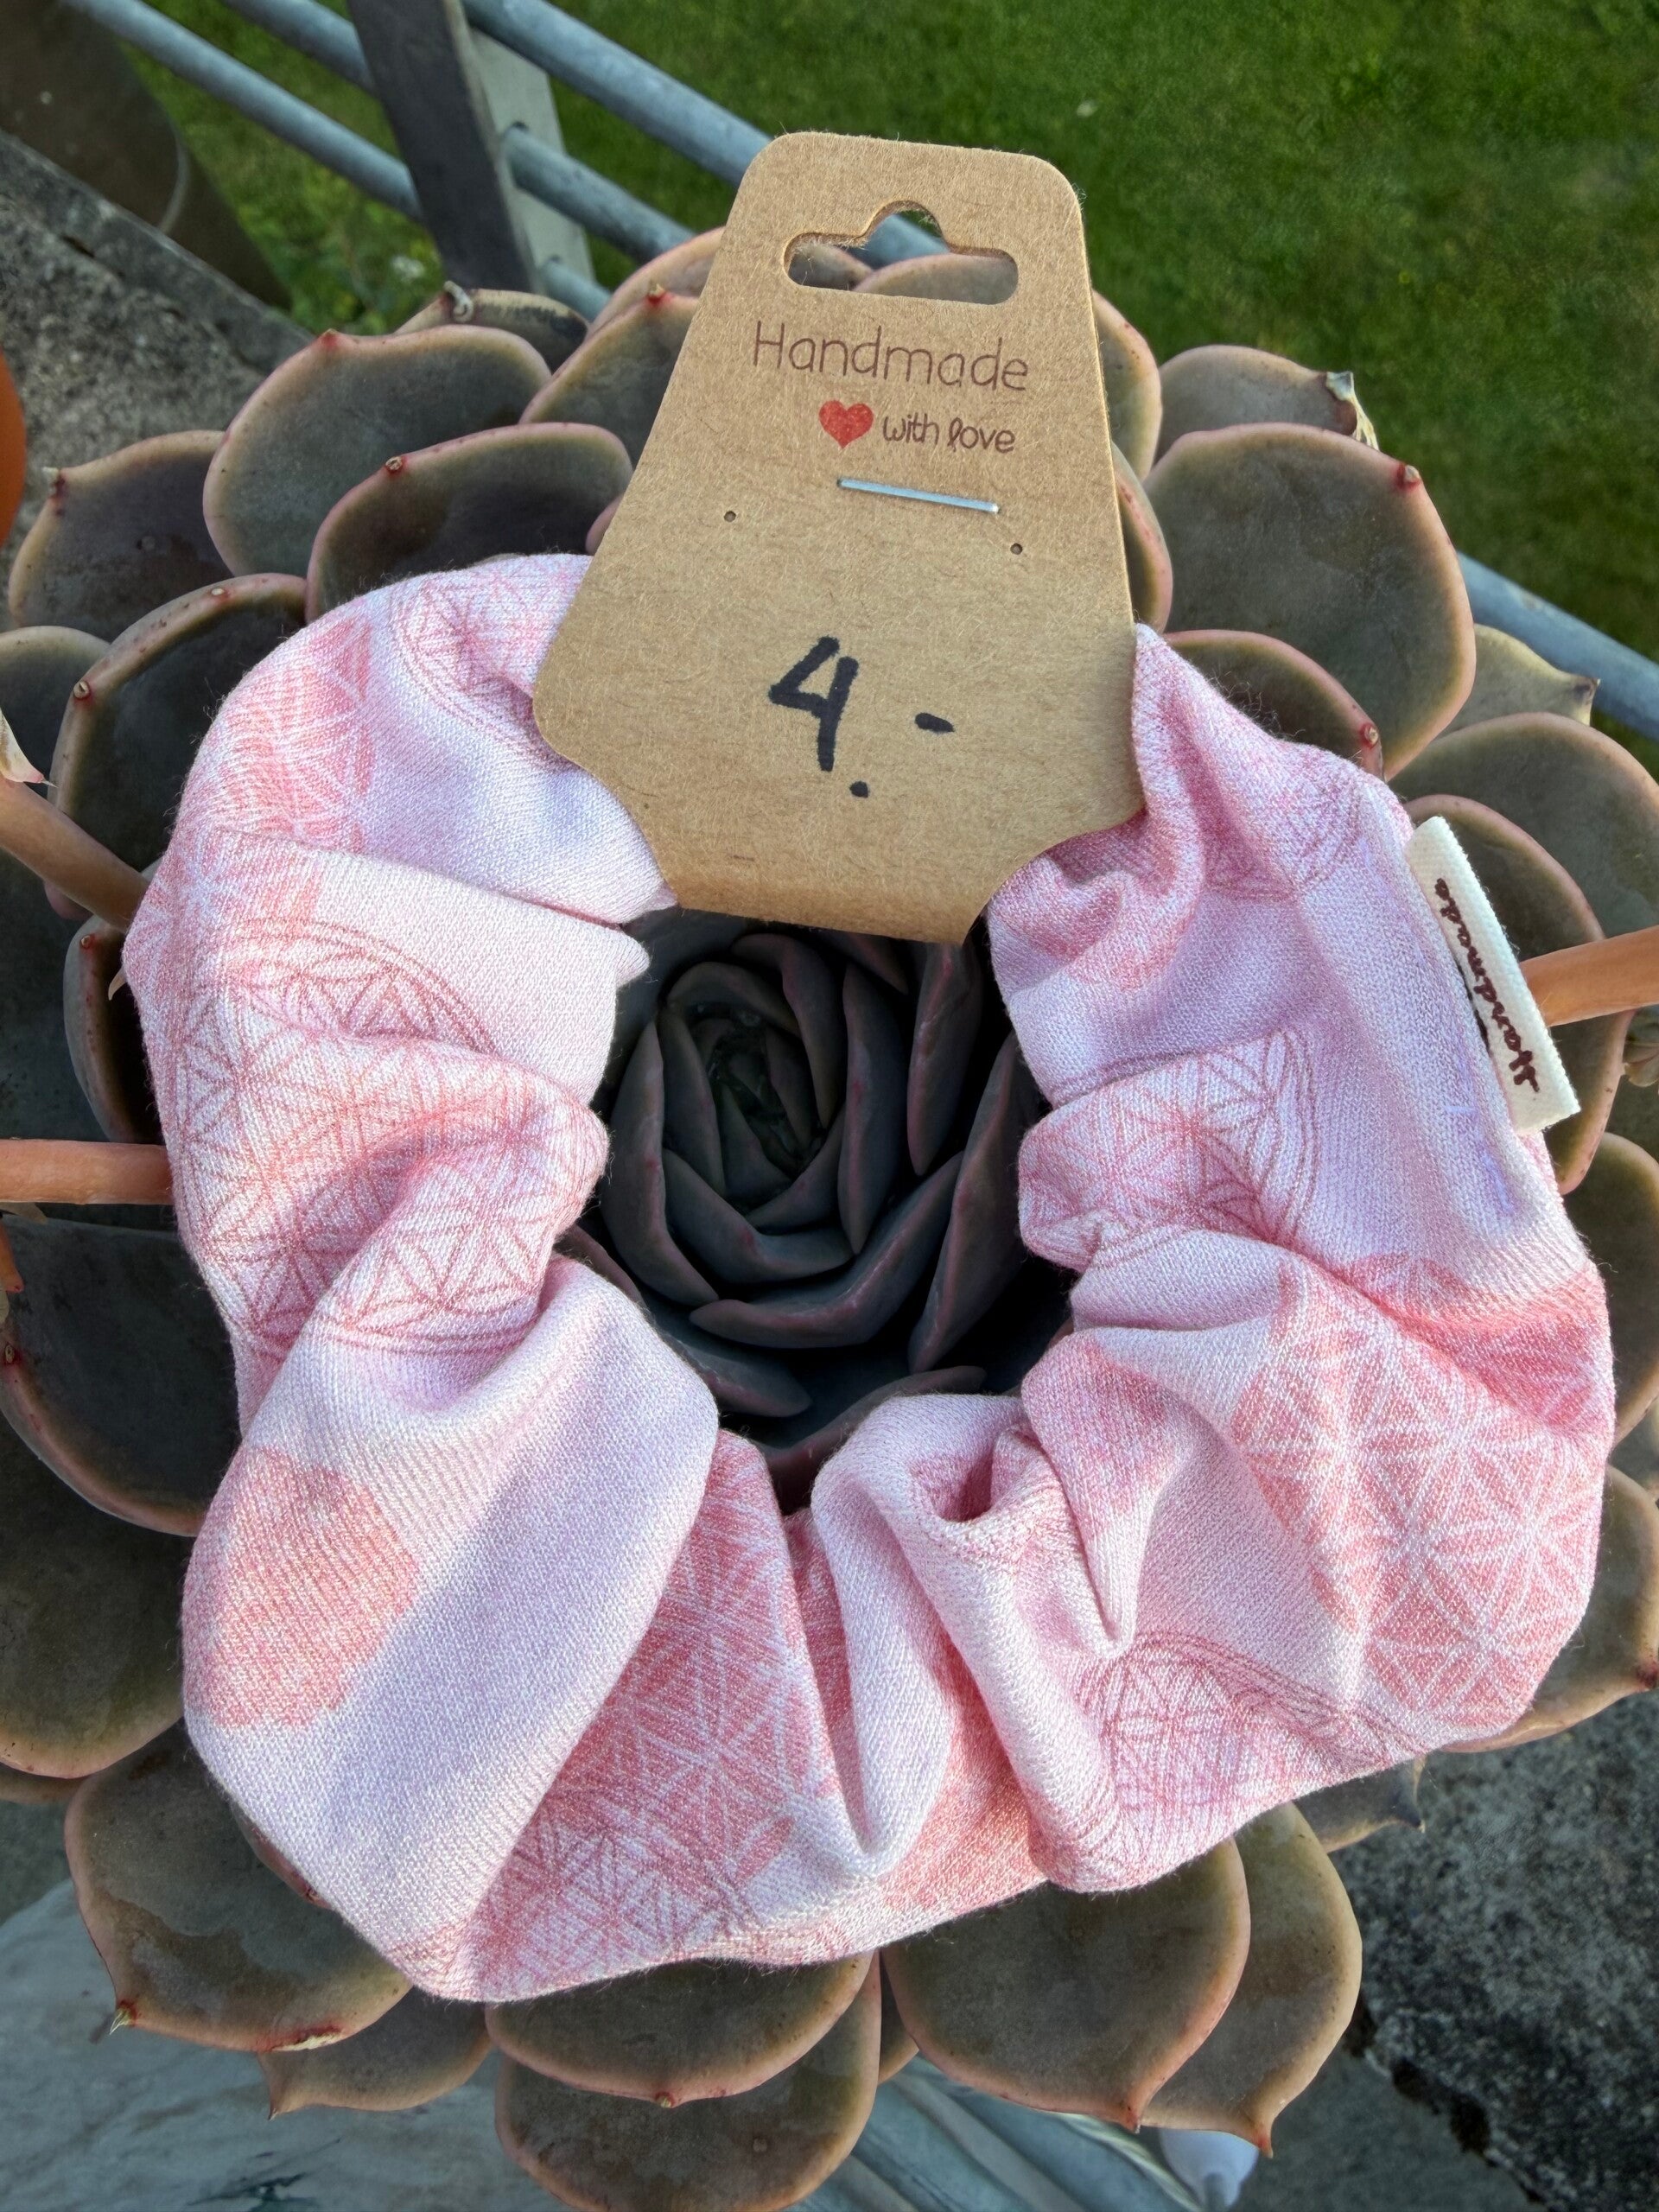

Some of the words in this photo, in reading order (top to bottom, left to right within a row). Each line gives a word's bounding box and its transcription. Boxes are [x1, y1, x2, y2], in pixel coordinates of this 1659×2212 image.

[753, 320, 1029, 391] Handmade
[881, 412, 939, 446] with
[946, 416, 1016, 454] love
[1434, 877, 1541, 1093] Handmade
